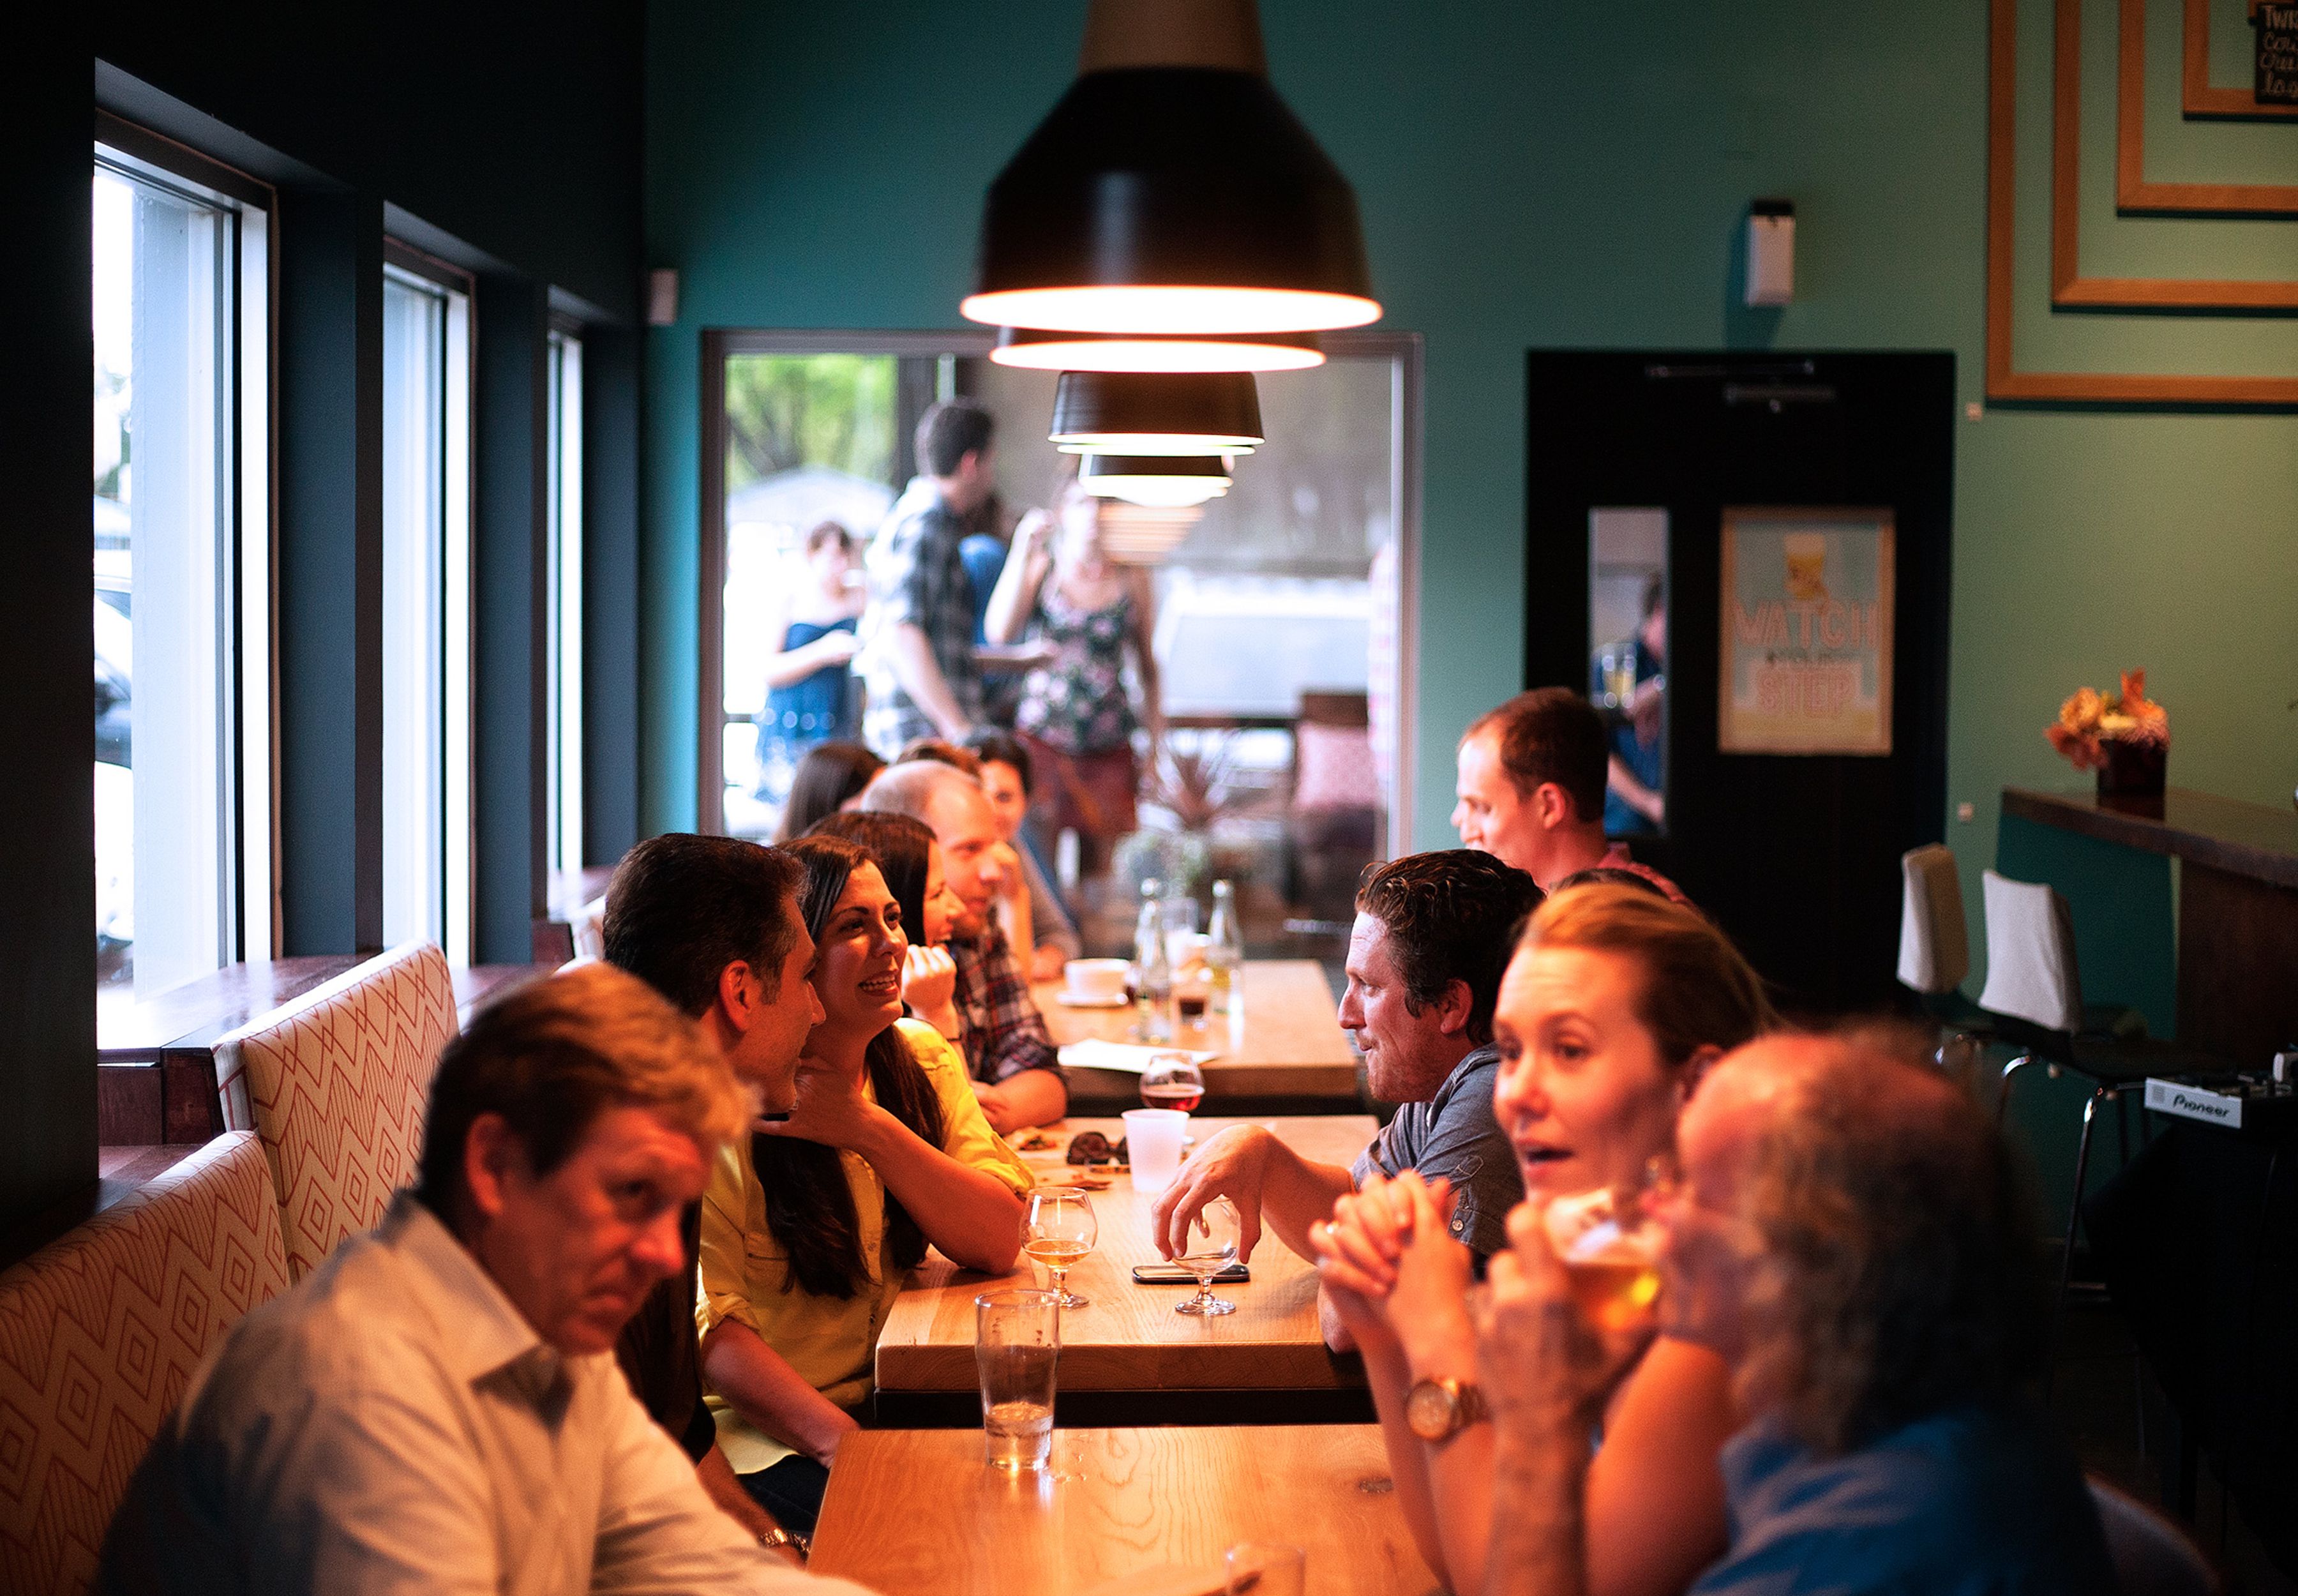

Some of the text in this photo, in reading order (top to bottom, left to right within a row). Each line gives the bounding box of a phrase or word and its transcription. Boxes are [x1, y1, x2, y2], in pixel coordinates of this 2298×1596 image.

[1734, 599, 1879, 649] WATCH
[1756, 667, 1855, 718] STEP
[2173, 1093, 2230, 1118] Pioneer
